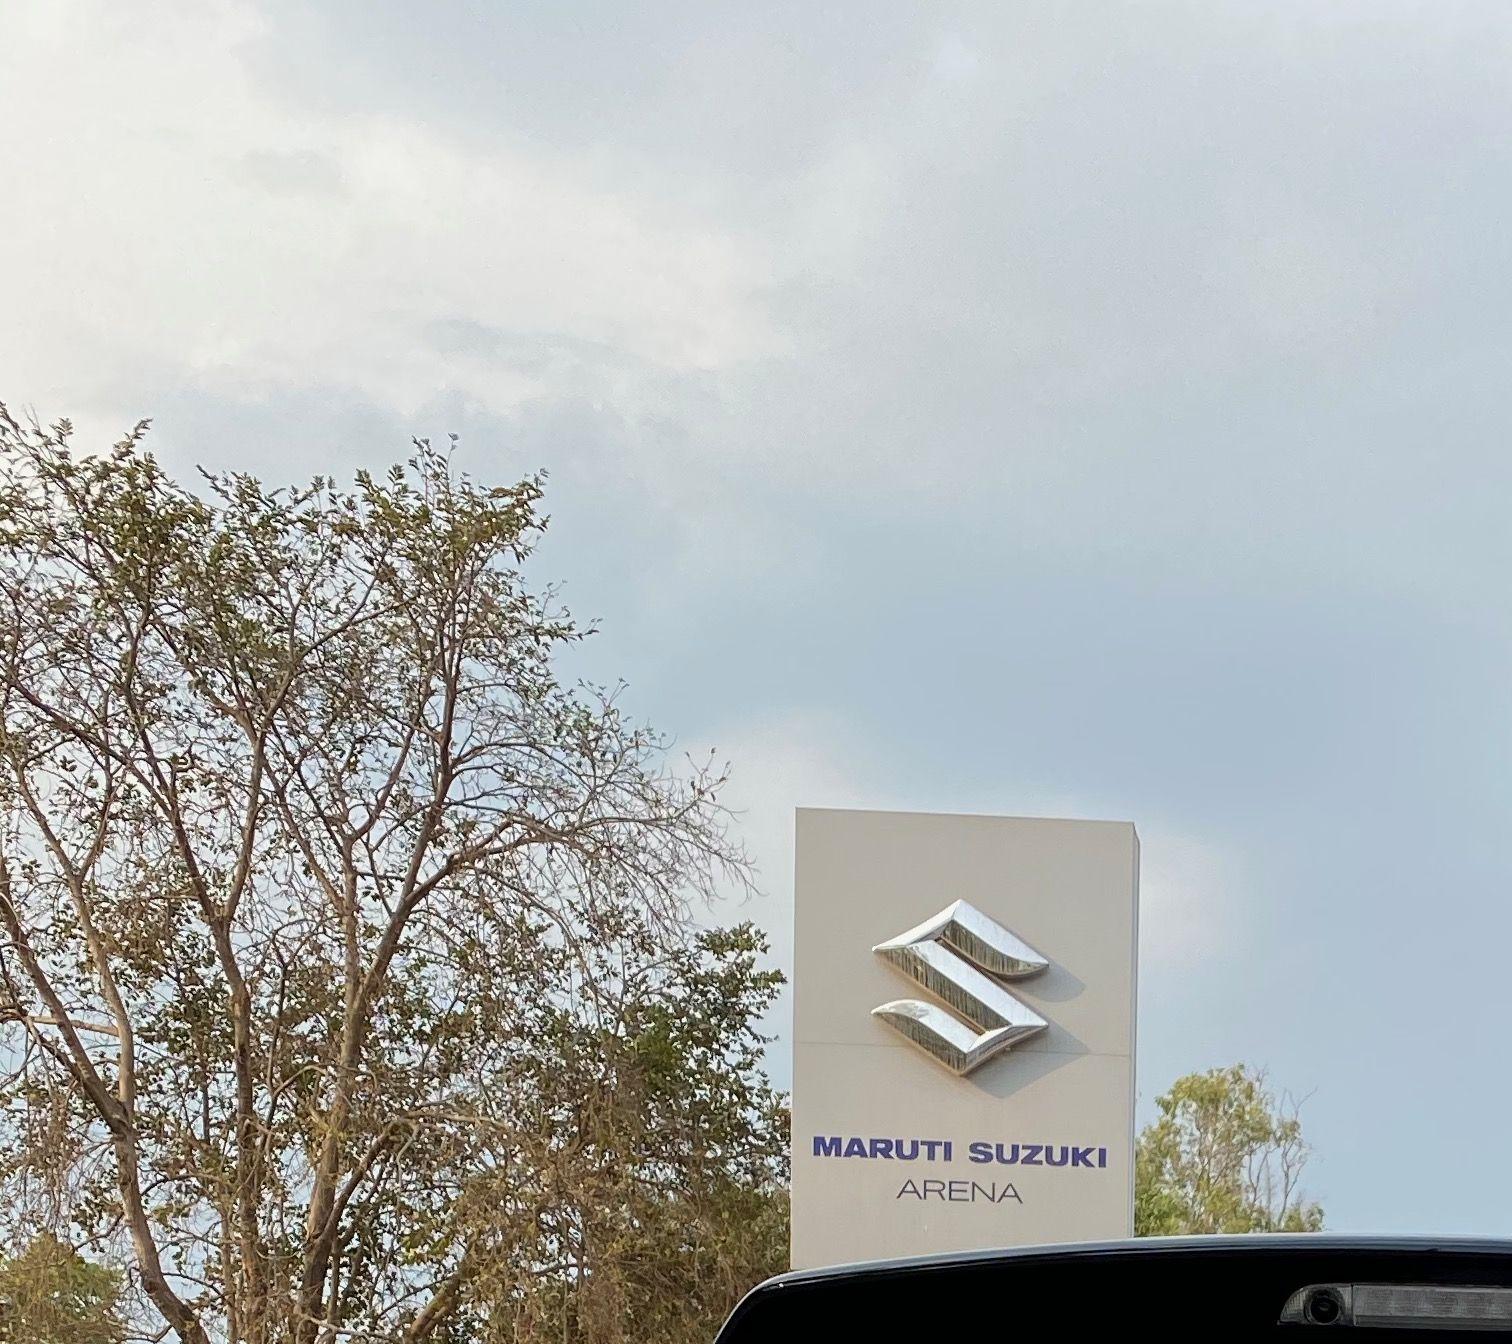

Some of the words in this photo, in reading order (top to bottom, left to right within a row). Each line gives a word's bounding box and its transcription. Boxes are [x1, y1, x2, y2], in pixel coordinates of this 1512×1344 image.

[812, 1136, 952, 1161] MARUTI
[968, 1142, 1107, 1168] SUZUKI
[896, 1179, 1023, 1204] ARENA
